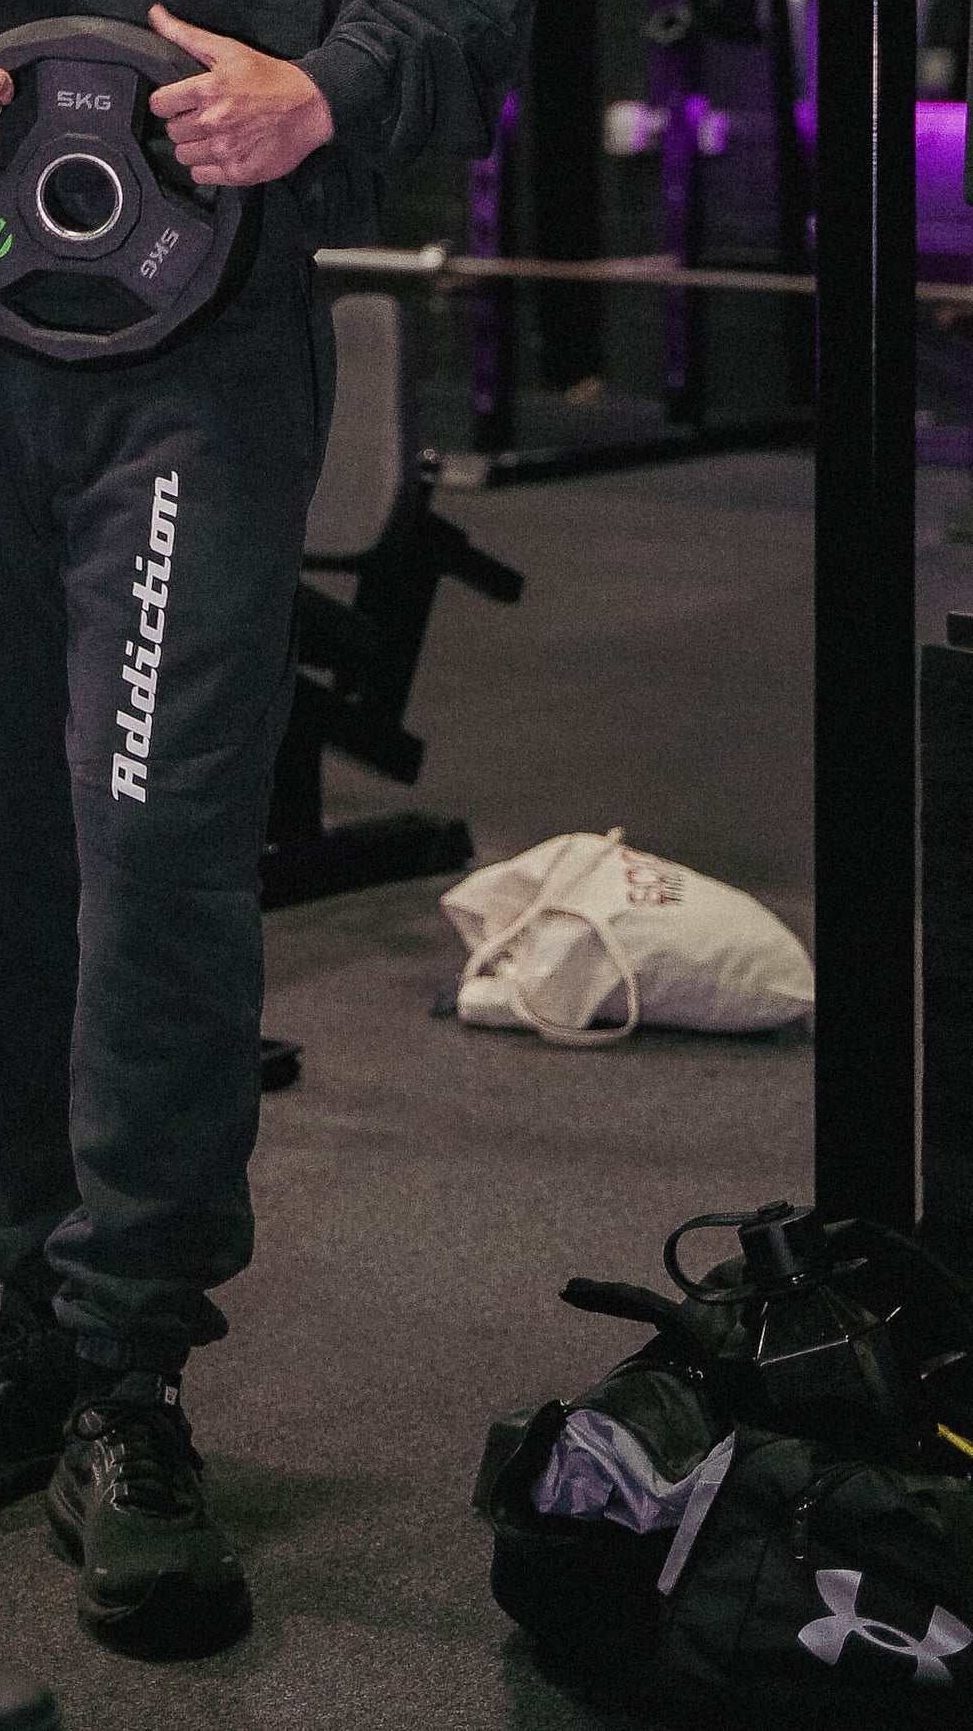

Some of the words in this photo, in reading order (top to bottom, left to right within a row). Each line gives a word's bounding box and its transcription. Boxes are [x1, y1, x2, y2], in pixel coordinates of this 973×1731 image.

[56, 90, 112, 111] 5KG
[139, 227, 180, 280] 5KG
[111, 470, 180, 804] Addiction
